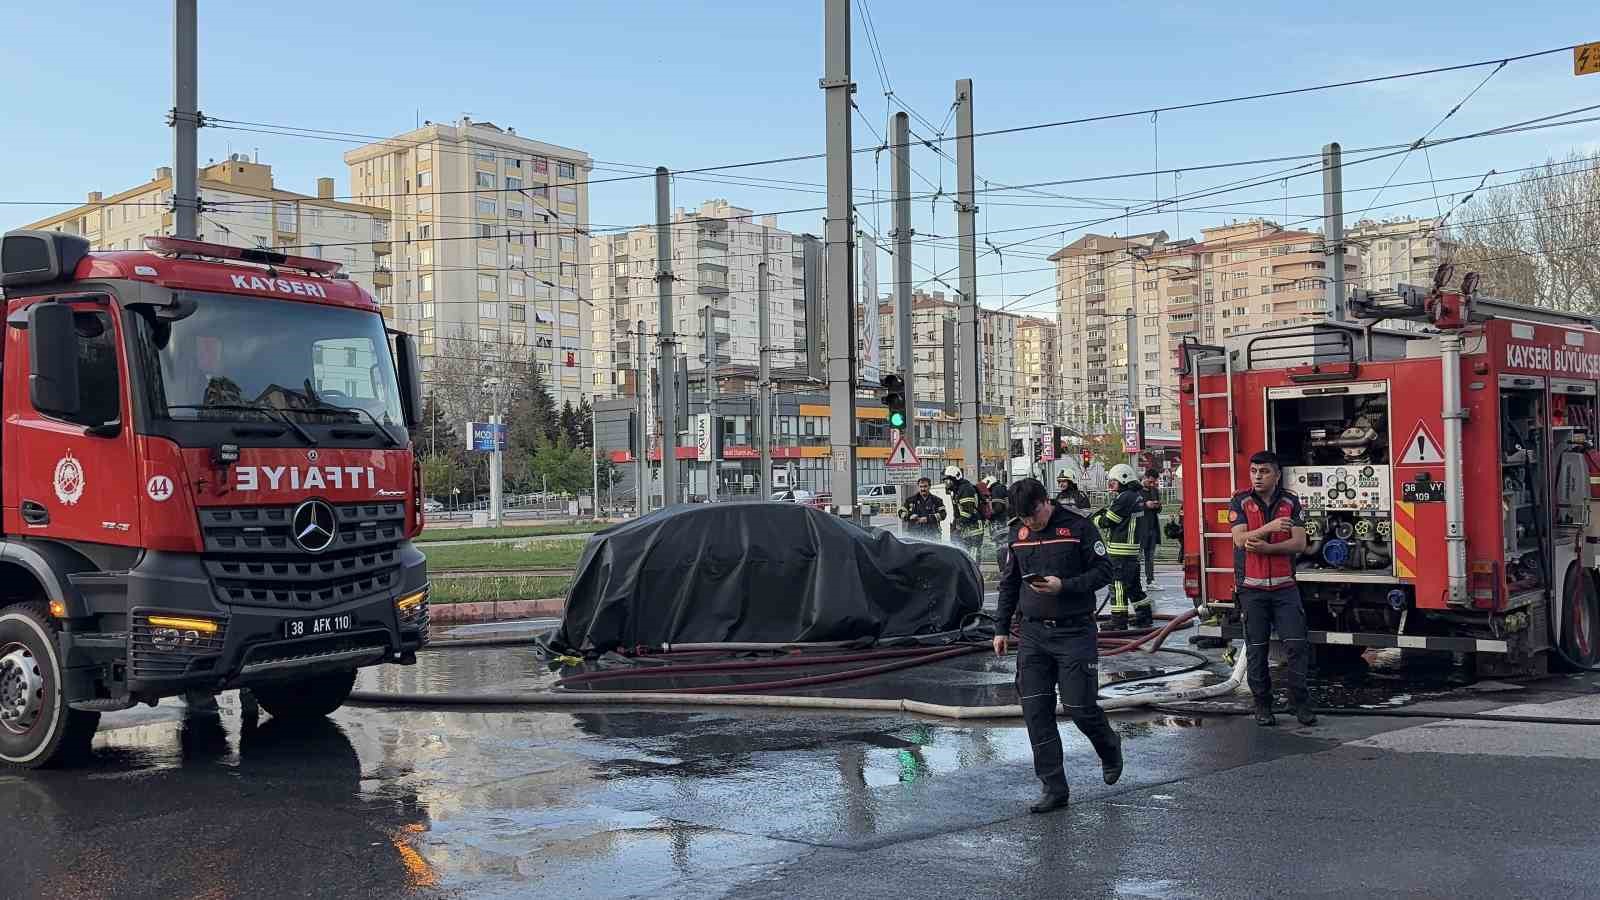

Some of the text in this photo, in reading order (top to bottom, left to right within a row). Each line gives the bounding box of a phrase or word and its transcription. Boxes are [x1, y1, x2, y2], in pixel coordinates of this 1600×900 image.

[1506, 343, 1552, 370] KAYSERİ
[150, 478, 168, 496] 44
[1430, 483, 1442, 491] VY
[1415, 492, 1430, 501] 109
[291, 615, 349, 635] 38 AFK 110
